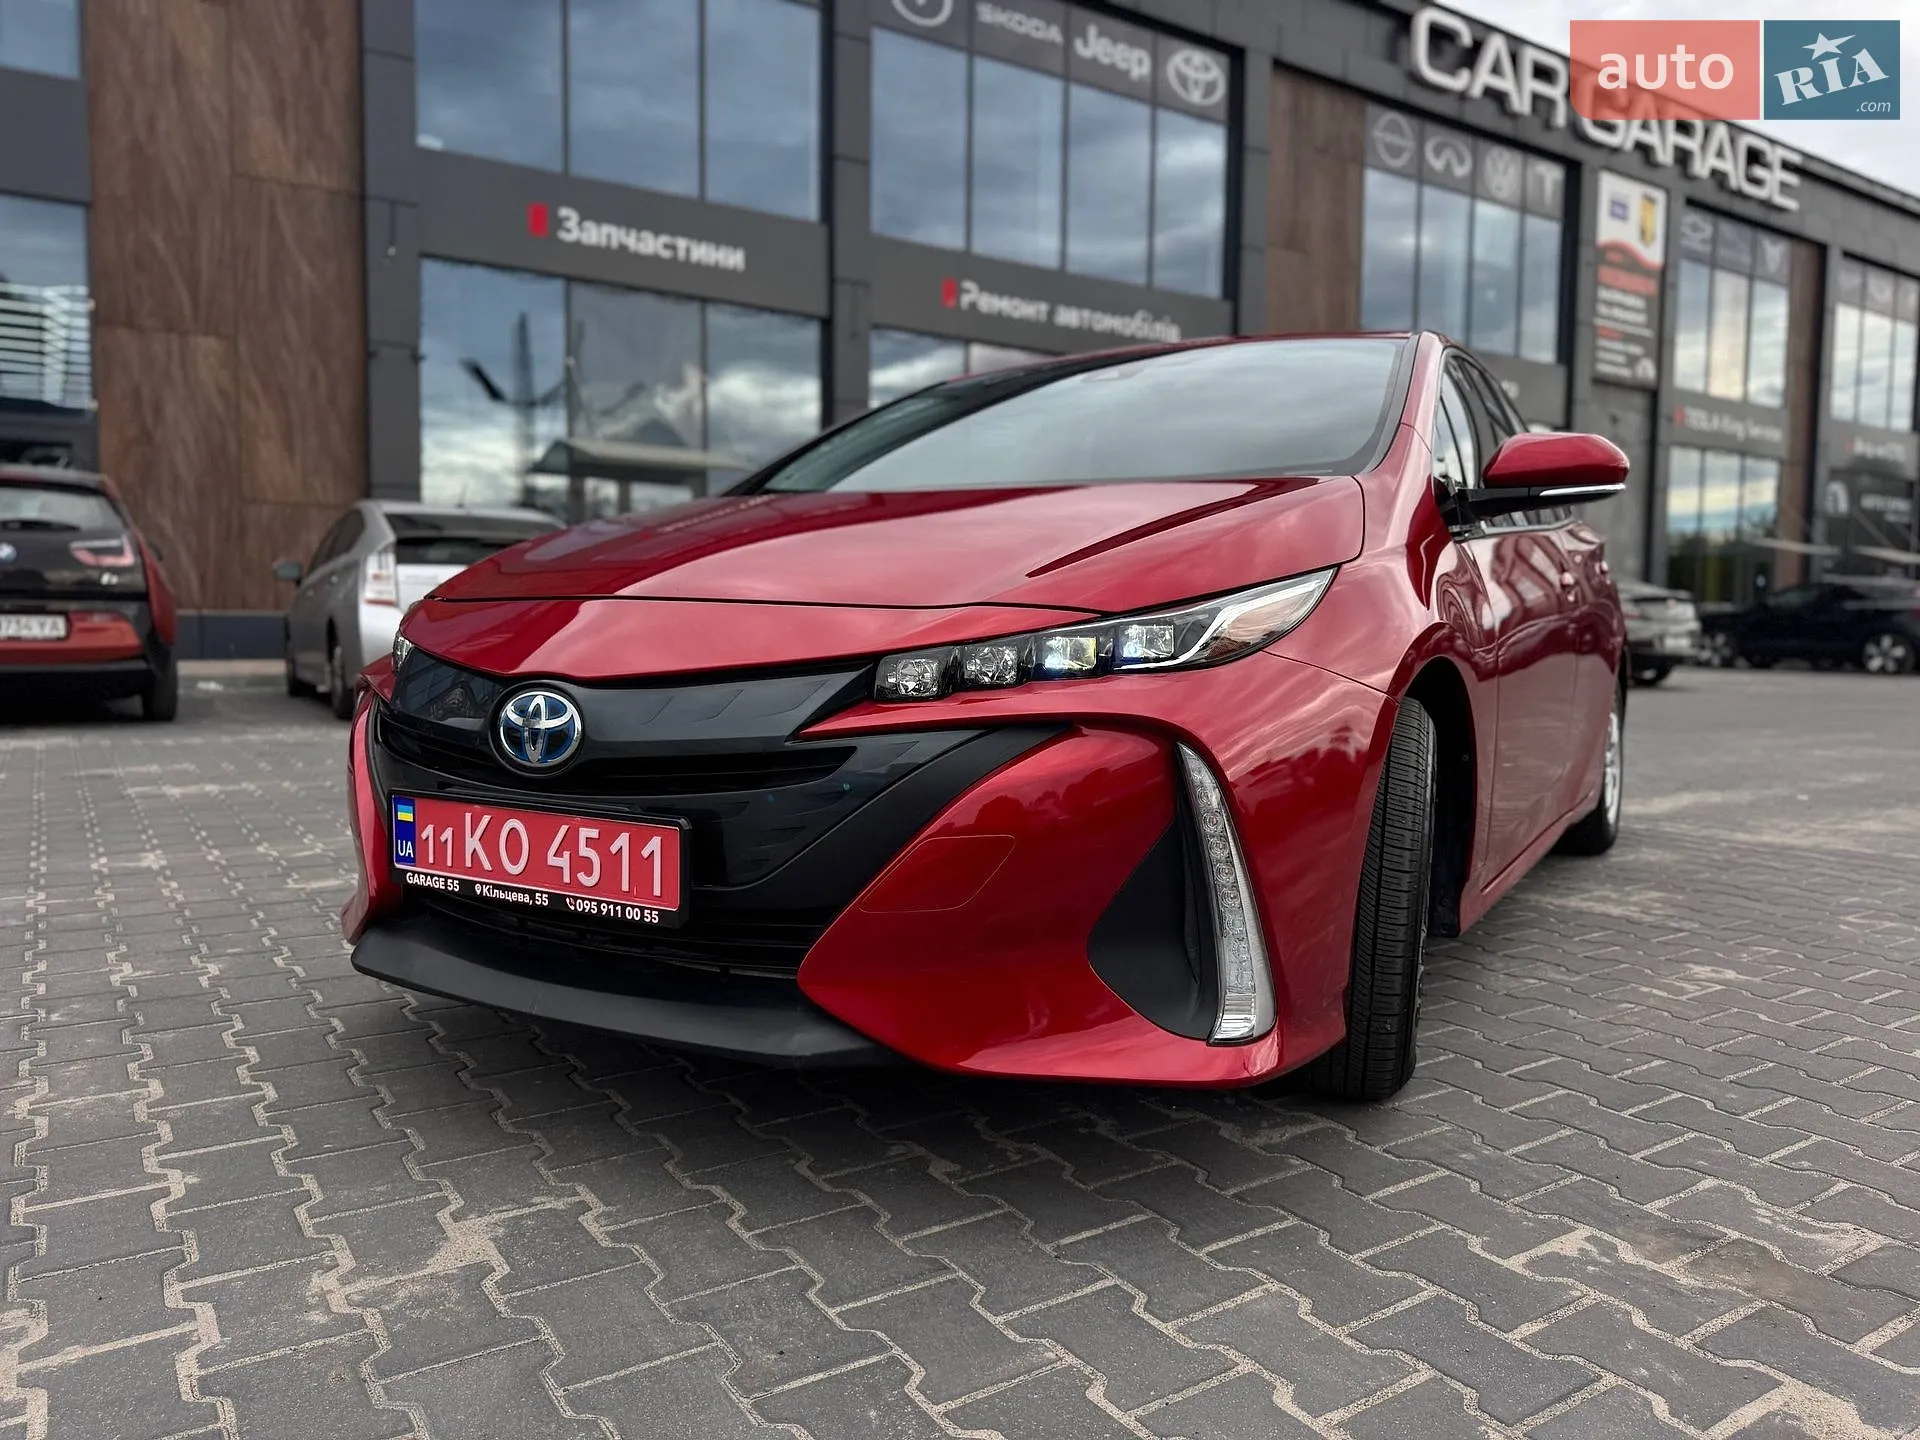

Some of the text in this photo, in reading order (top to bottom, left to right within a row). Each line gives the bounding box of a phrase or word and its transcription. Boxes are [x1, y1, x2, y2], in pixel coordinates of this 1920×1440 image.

[1074, 24, 1151, 80] Jeep
[1411, 7, 1801, 211] CAR GARAGE
[557, 206, 747, 272] Запчастини
[960, 278, 1049, 322] Ремонт
[397, 839, 414, 858] UA
[547, 824, 662, 897] 4511
[406, 871, 460, 892] GARAGE 55
[482, 884, 549, 906] Кільцева, 55
[575, 898, 659, 924] 095 911 00 55
